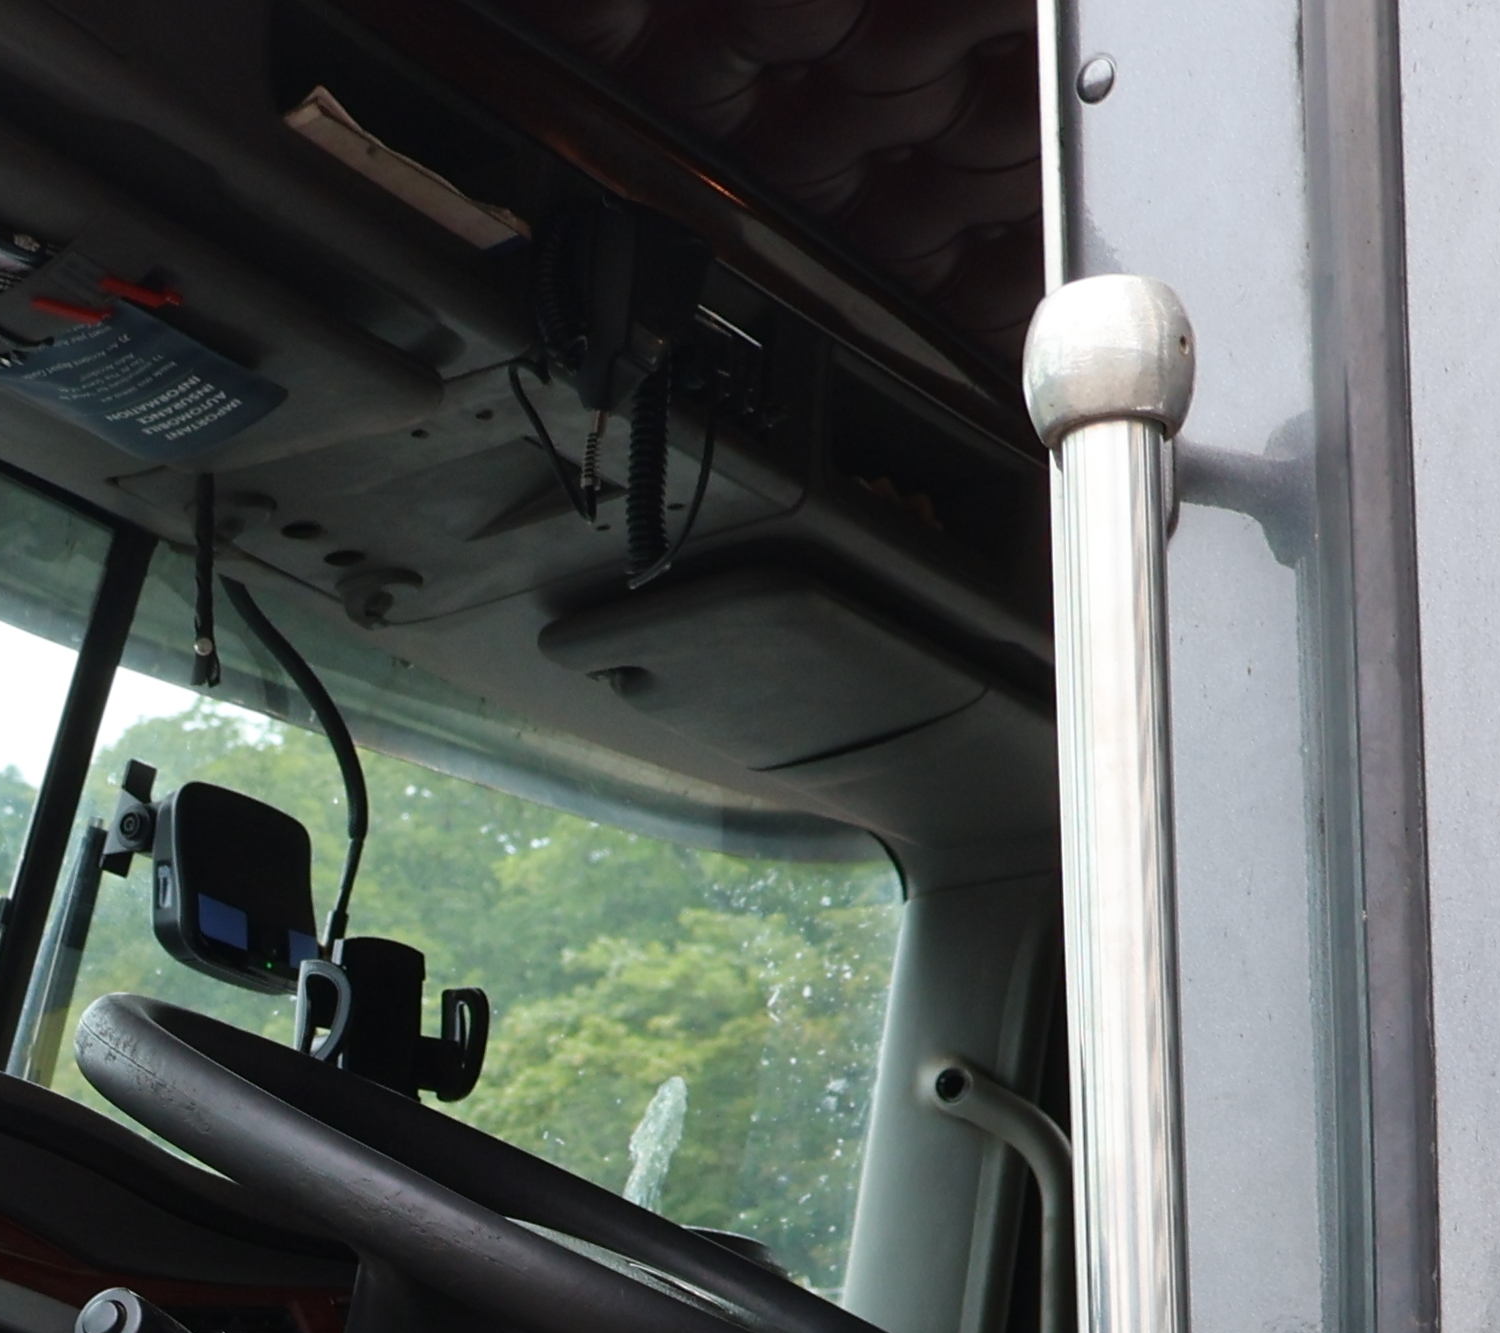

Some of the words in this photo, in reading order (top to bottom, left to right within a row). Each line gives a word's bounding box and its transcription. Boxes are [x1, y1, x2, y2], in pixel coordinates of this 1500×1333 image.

[104, 374, 201, 423] INFORMATION
[136, 383, 216, 425] INSURANCE
[141, 390, 227, 435] AUTOMOBILE
[165, 398, 243, 441] IMPORTANT
